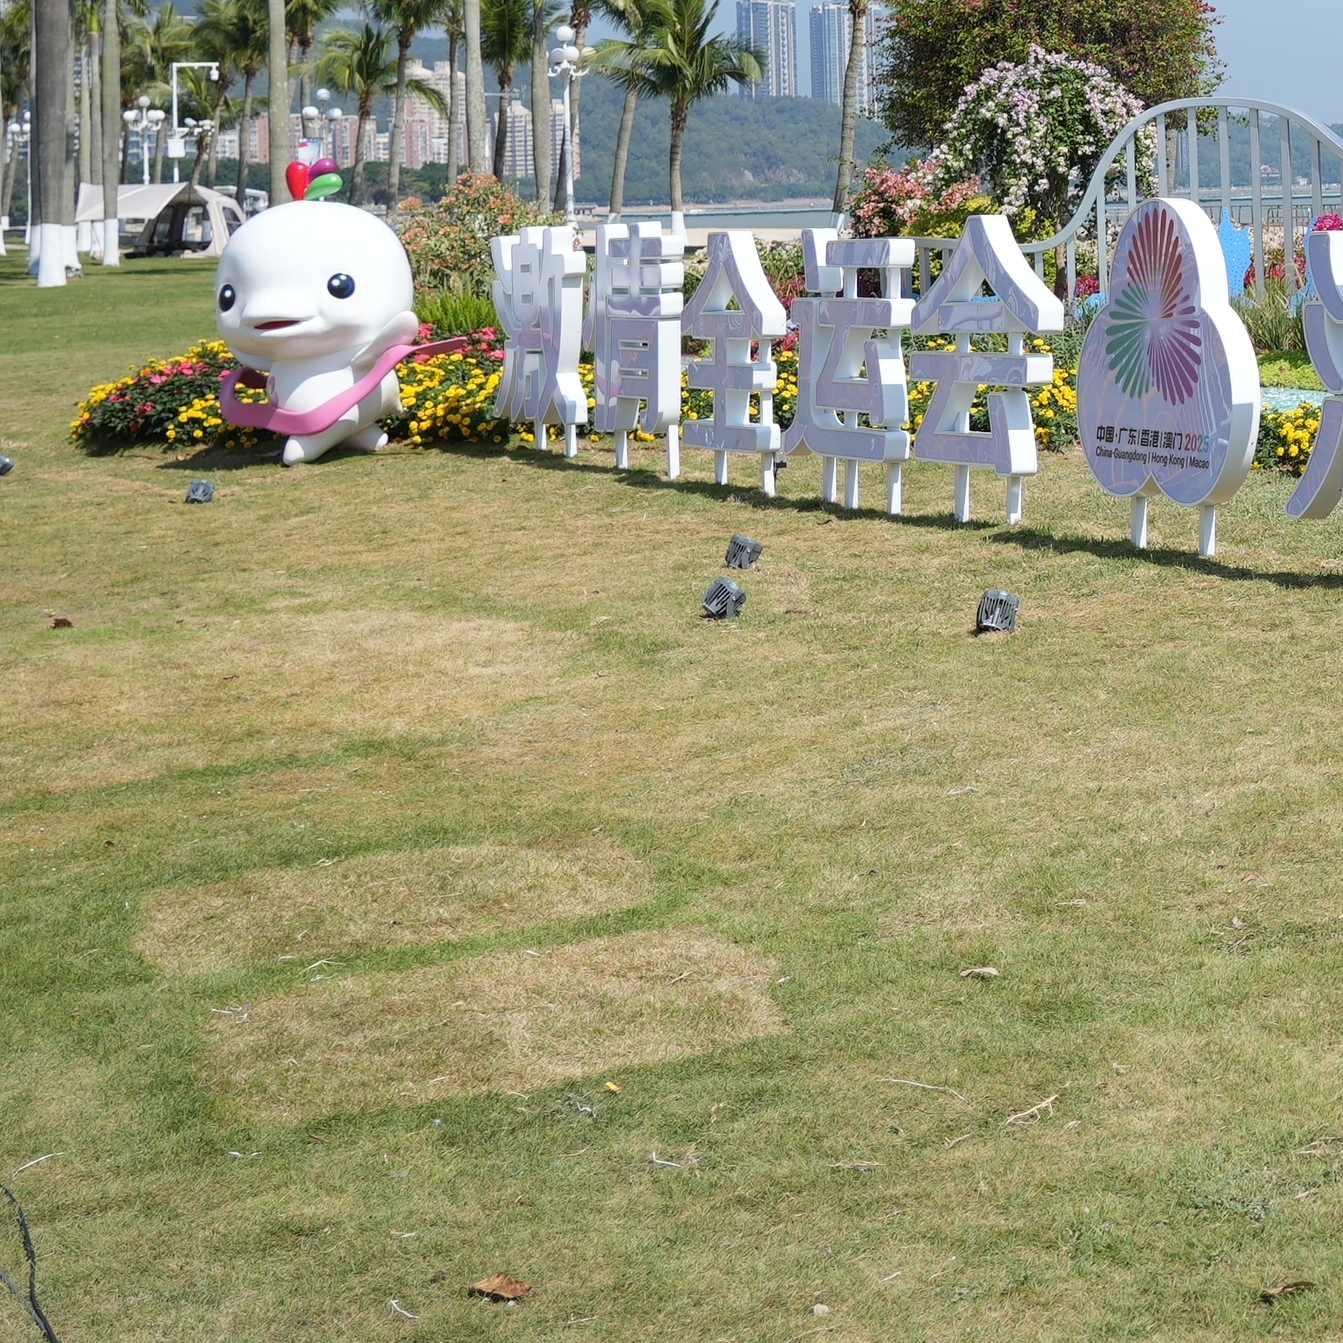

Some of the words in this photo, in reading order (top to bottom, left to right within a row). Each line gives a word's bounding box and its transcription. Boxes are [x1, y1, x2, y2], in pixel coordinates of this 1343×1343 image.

[490, 214, 1064, 477] 激情全运会
[1184, 433, 1210, 454] 2025
[1151, 452, 1167, 467] Hong
[1169, 455, 1185, 469] Kong
[1189, 457, 1210, 469] Macao
